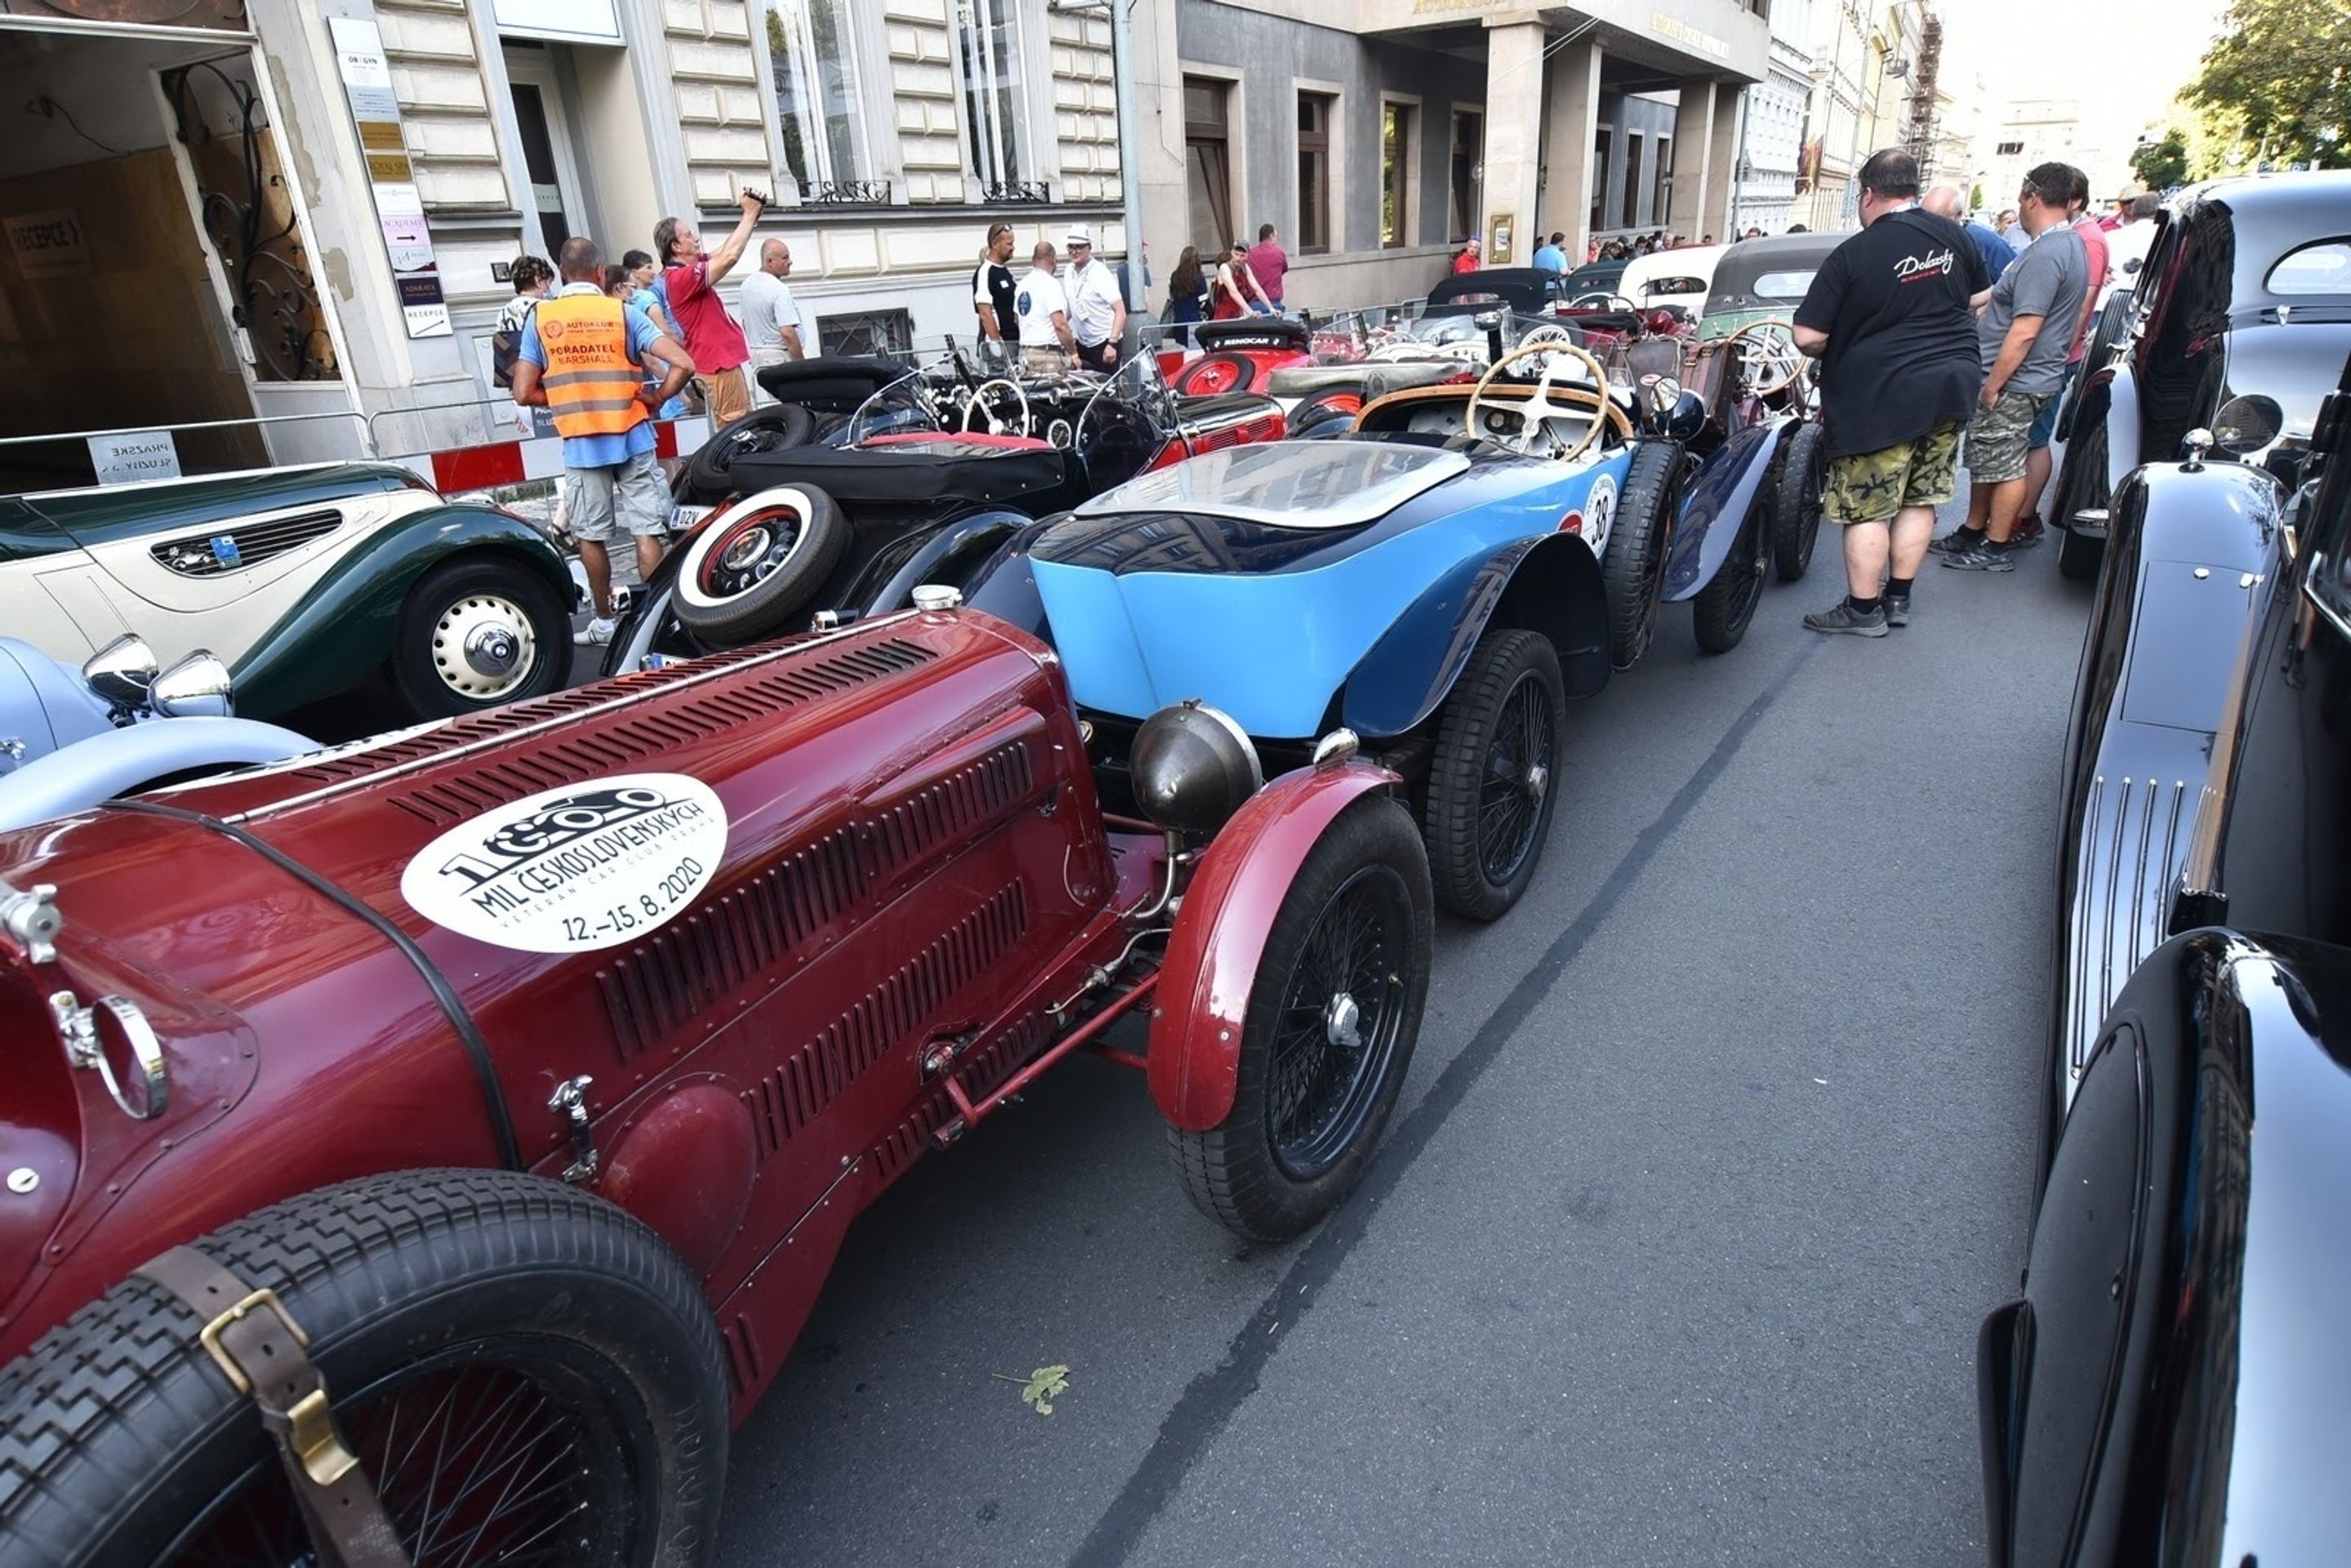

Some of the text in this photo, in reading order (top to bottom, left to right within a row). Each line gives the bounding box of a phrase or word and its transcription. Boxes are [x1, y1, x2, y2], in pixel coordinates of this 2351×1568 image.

[408, 310, 444, 318] RECEPCE
[559, 354, 614, 365] MARSHALL
[1224, 337, 1269, 345] RENOCAR
[1591, 495, 1609, 546] 38
[471, 802, 706, 918] MIL ČESKOSLOVENSKÝCH
[500, 817, 715, 929] VETERAN CAR CLUB PRAHA
[658, 857, 703, 904] 2020
